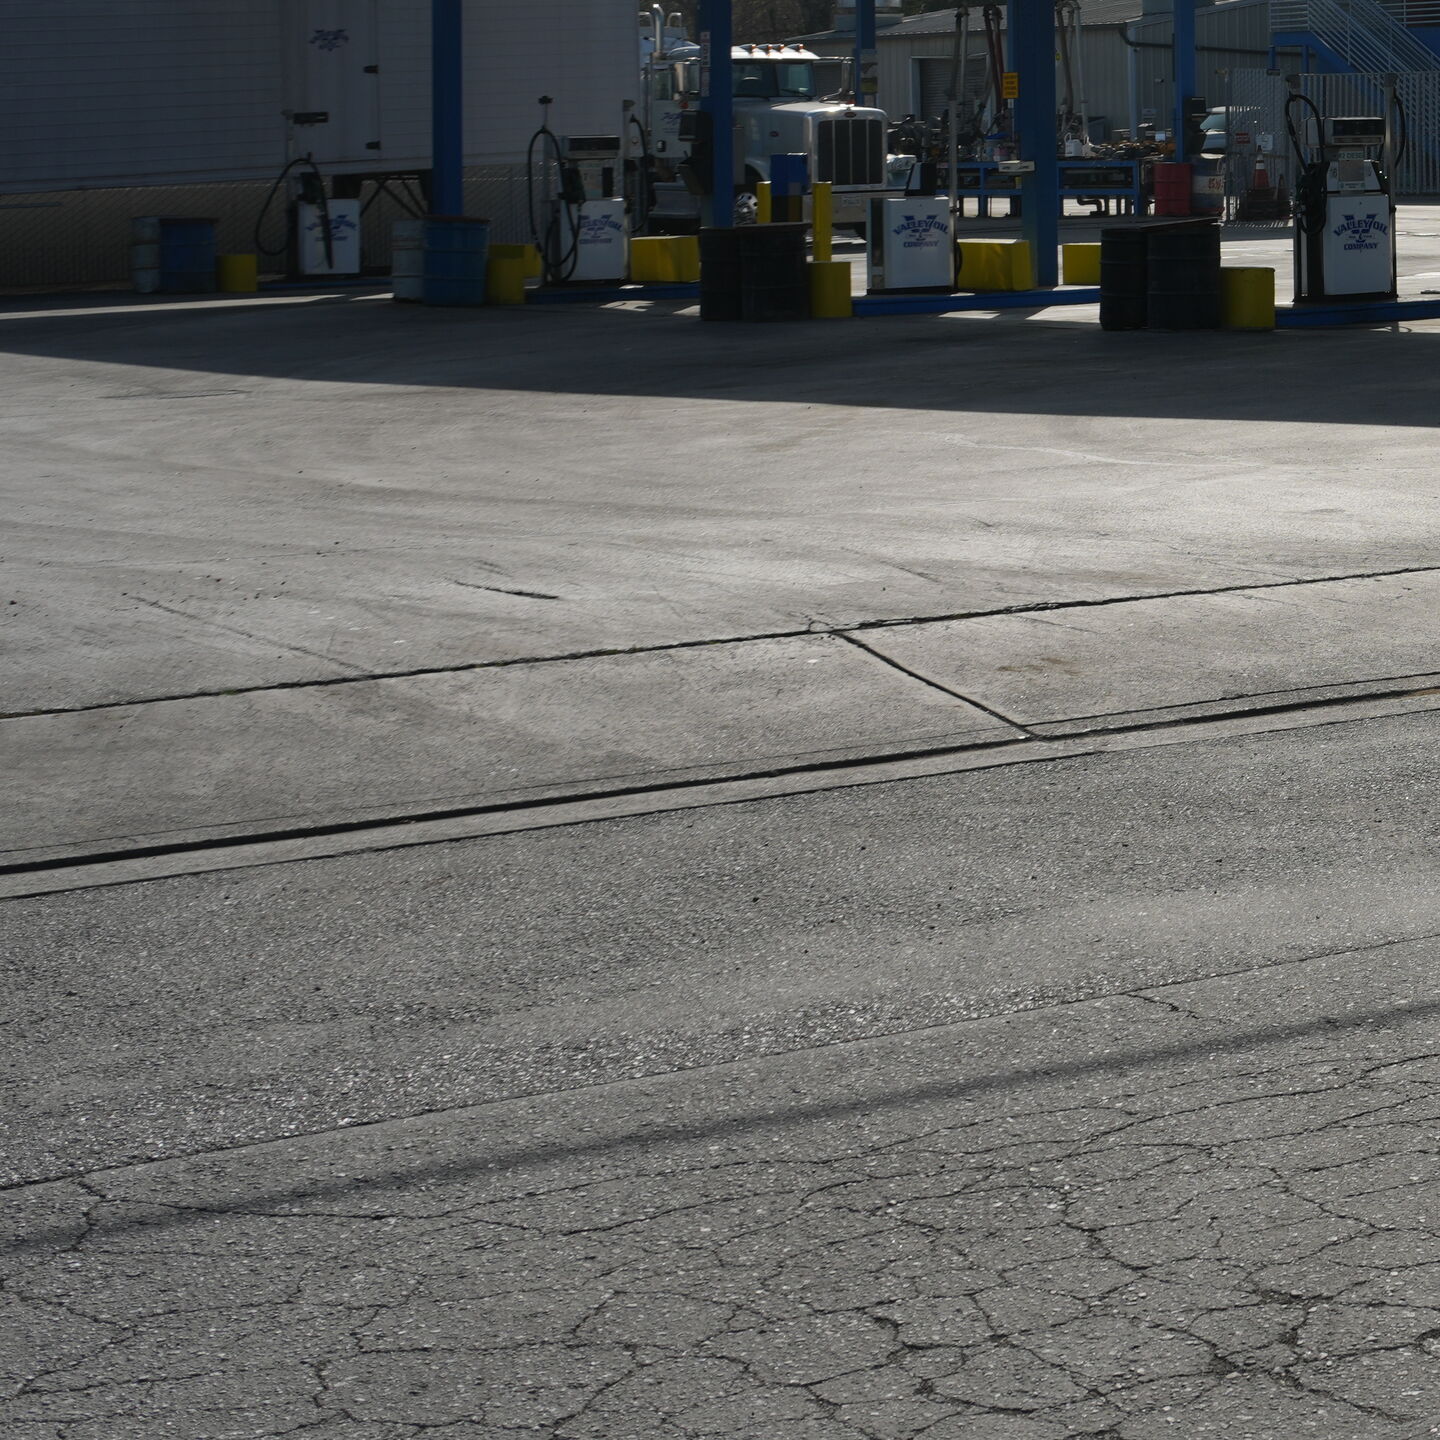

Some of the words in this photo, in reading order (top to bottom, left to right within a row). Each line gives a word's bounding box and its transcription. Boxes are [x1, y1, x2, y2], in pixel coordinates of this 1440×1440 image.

[1333, 220, 1371, 236] VALLEY
[1373, 221, 1389, 236] OIL
[1343, 242, 1378, 251] COMPANY
